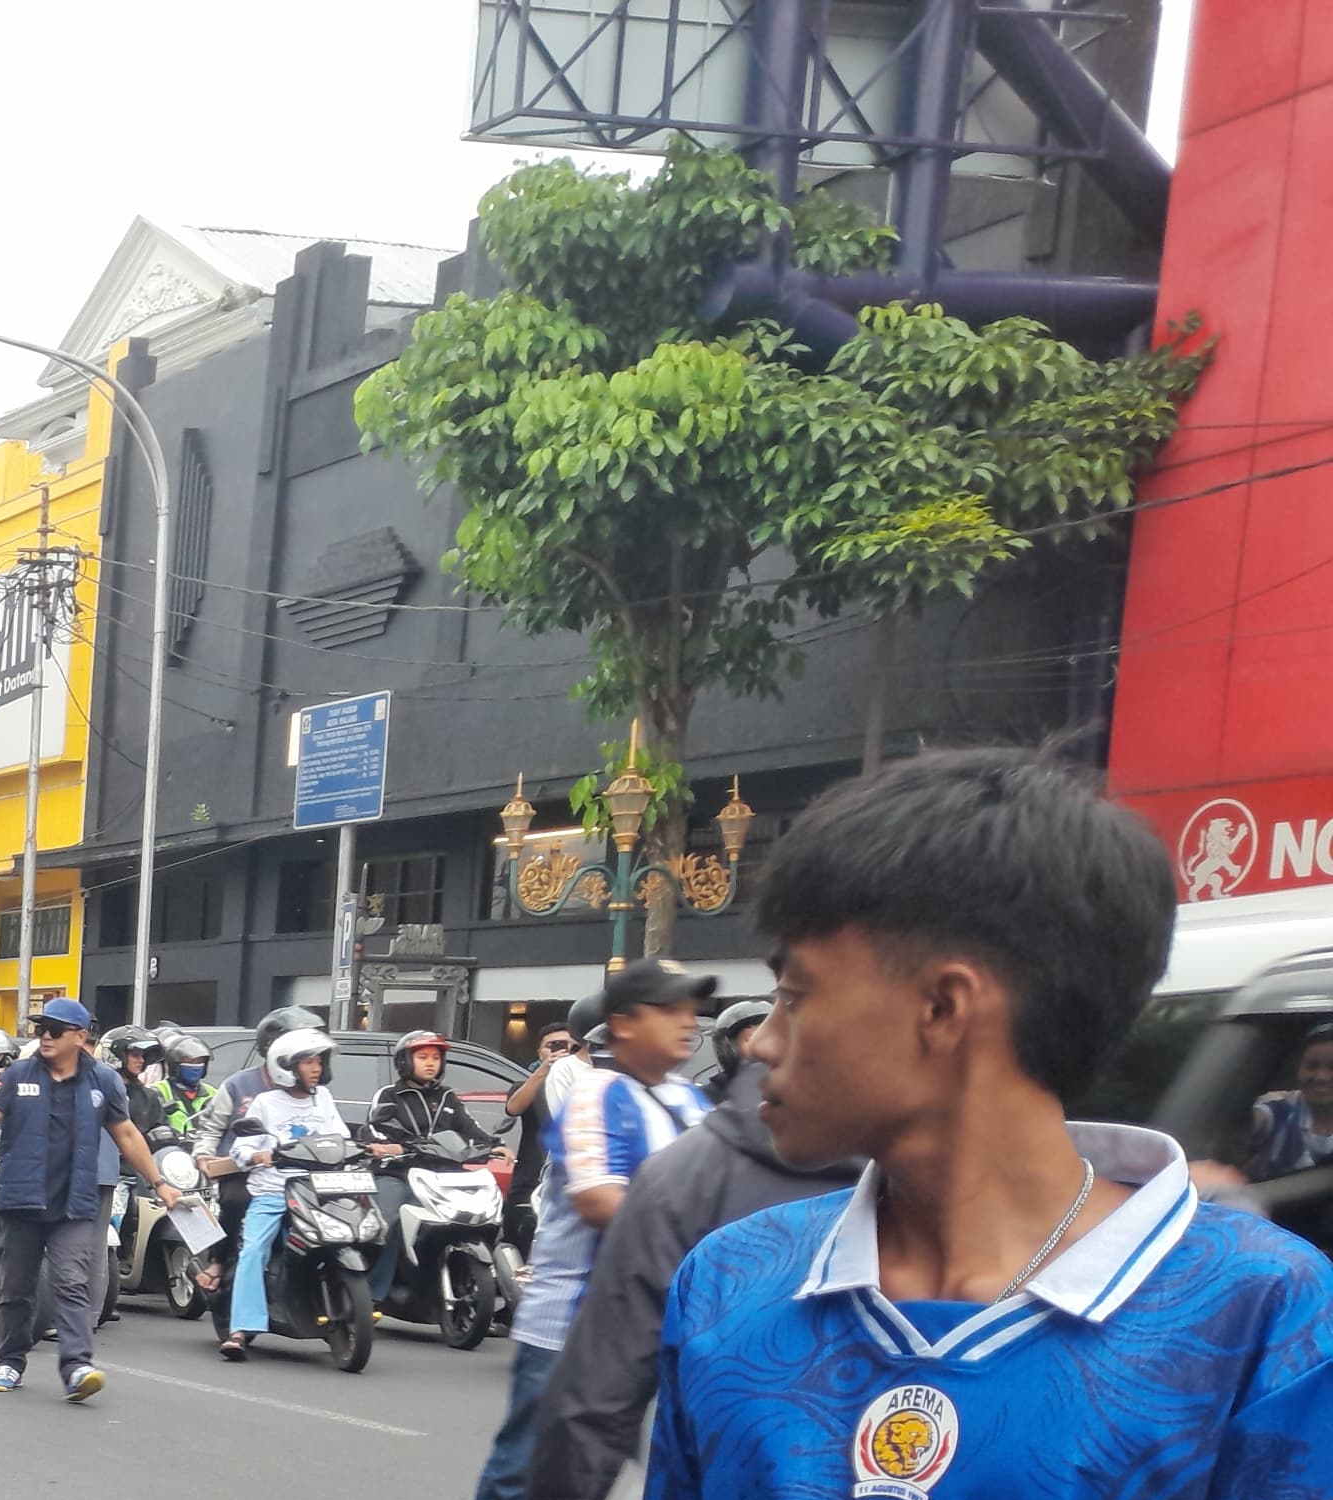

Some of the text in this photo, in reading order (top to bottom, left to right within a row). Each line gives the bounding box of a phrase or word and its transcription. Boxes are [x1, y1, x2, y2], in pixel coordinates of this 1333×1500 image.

[3, 669, 37, 694] Datan
[341, 912, 351, 959] P
[884, 1386, 945, 1421] AREMA
